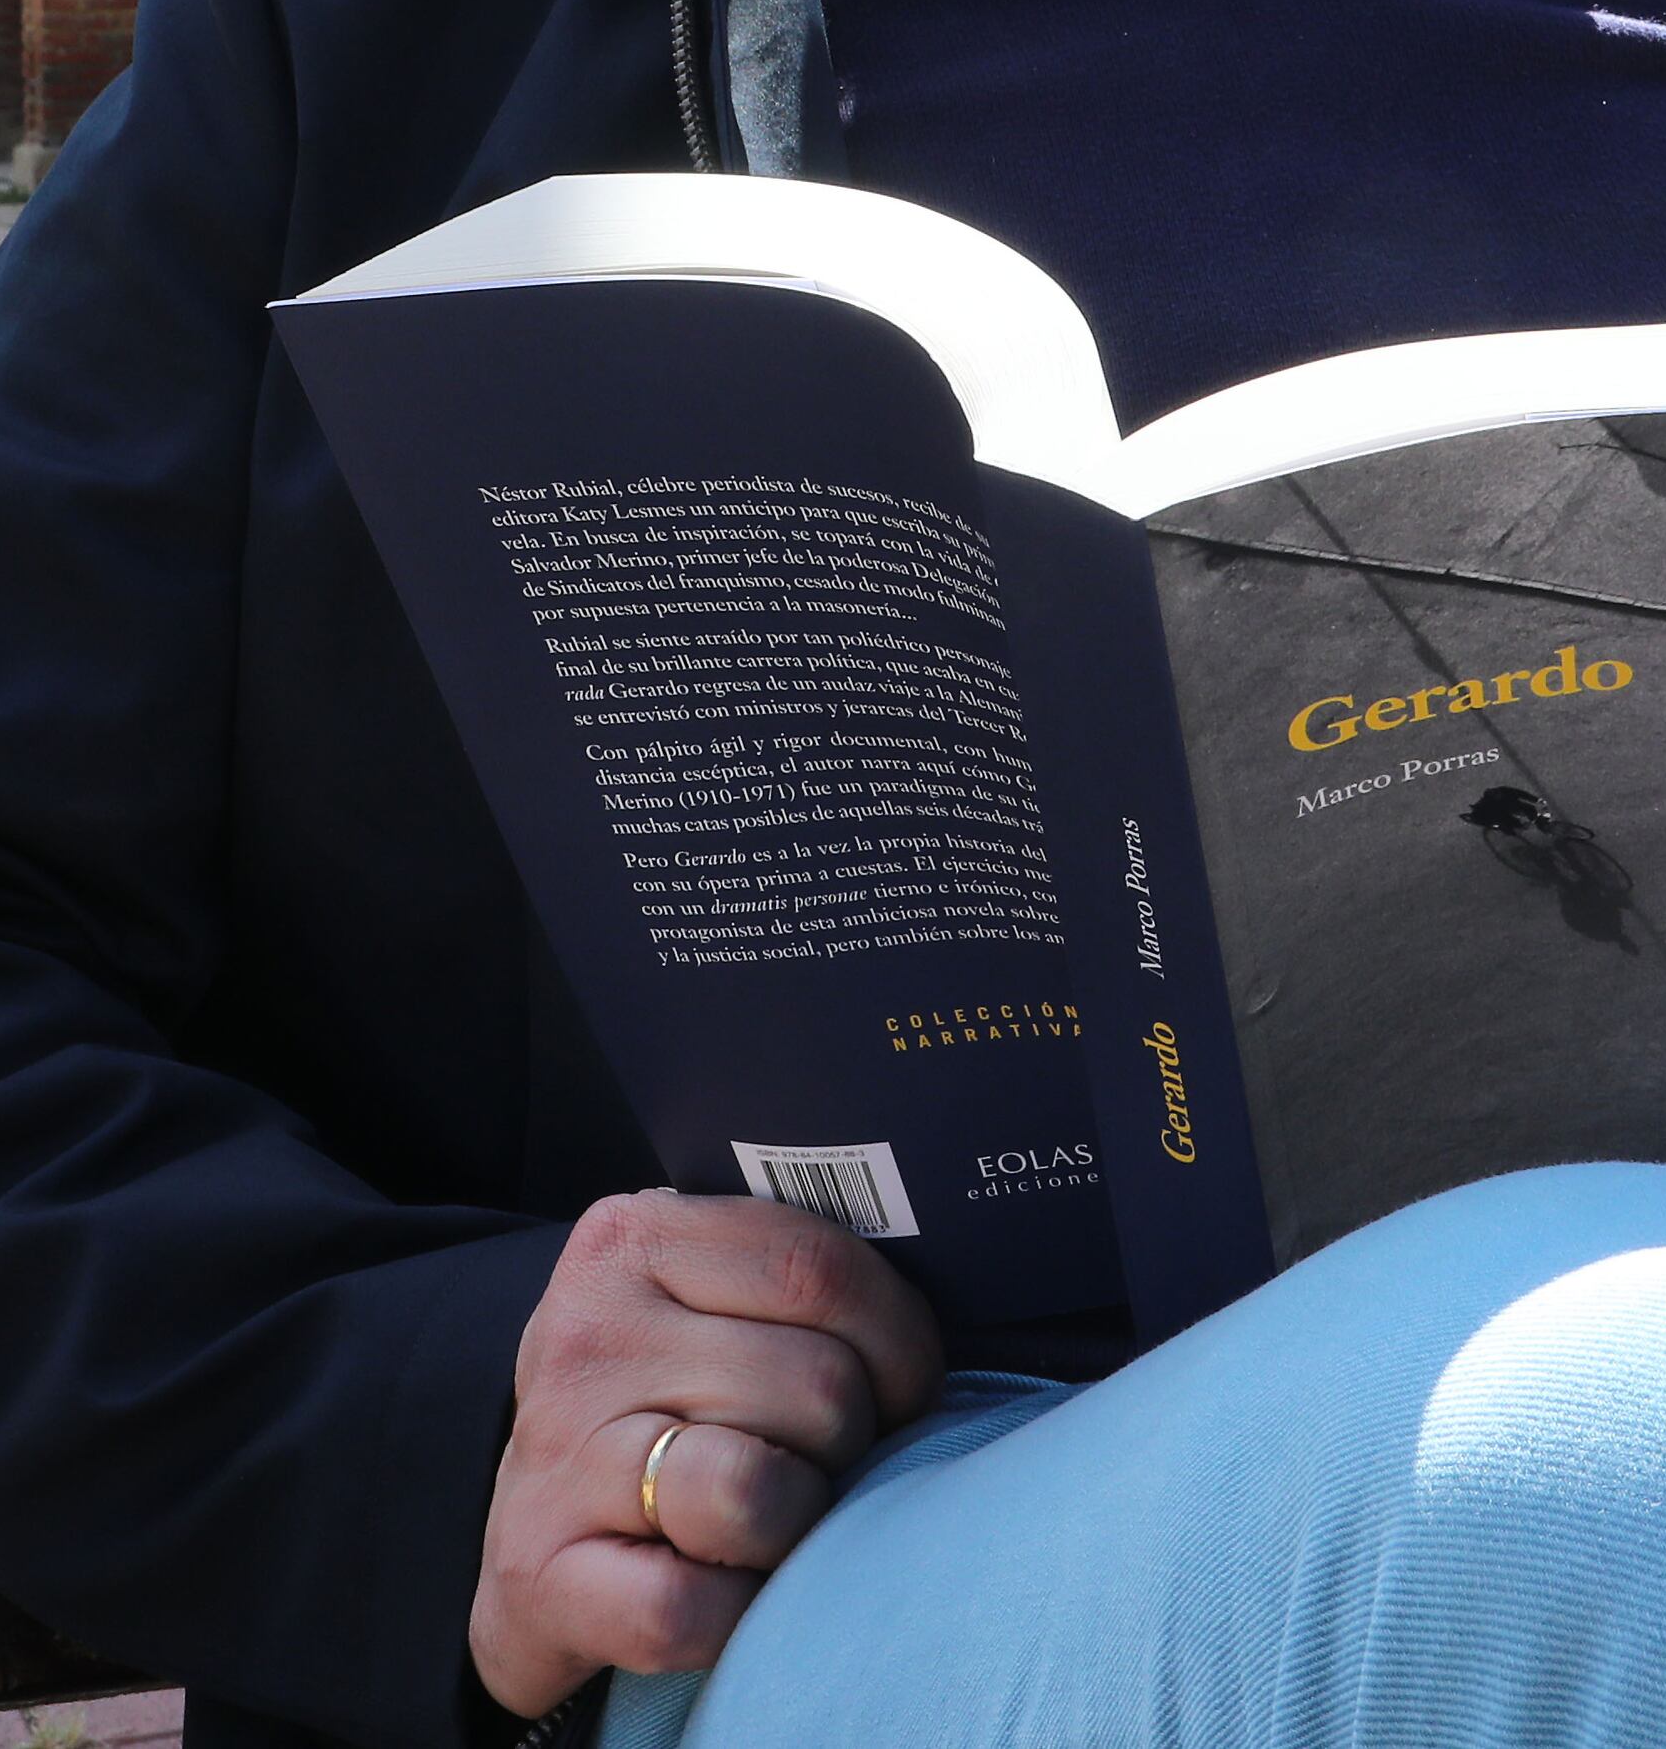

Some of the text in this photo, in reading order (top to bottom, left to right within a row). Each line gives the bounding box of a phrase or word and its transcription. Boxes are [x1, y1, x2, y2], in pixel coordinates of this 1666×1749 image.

[477, 474, 952, 525] Néstor Rubial, célebre periodista de sucesos, recibe
[491, 499, 941, 541] editora Katy Lesmes un anticipo para que escriba
[500, 523, 972, 575] vela. En busca de inspiración, se topará con la vida
[510, 547, 1001, 610] Salvador Merino, primer jefe de la poderosa Delegación
[522, 581, 546, 598] de
[546, 577, 644, 596] Sindicatos
[646, 573, 676, 591] del
[678, 572, 792, 593] franquismo,
[793, 573, 856, 591] cesado
[858, 575, 881, 594] de
[882, 583, 936, 603] modo
[532, 595, 918, 626] por supuesta pertenencia la masonería...
[544, 628, 1012, 679] Rubial se siente atraído por tan poliédrico personaje
[555, 652, 972, 685] final de su brillante carrera política, que acaba
[564, 674, 955, 702] rada Gerardo regresa de un audaz viaje la
[1288, 646, 1634, 752] Gerardo
[573, 698, 1006, 735] se entrevistó con ministros jerarcas del Tercer
[585, 730, 988, 764] Con pálpito ágil rigor documental, con
[595, 756, 1012, 786] distancia escéptica, el autor narra aquí cómo
[1296, 747, 1501, 818] Marco Porras
[601, 777, 994, 811] Merino (1910-1971) fue un paradigma de
[611, 799, 1020, 835] muchas catas posibles de aquellas seis décadas
[622, 832, 1048, 869] Pero Gerardo es la vez la propia historia del
[632, 855, 1020, 895] con su ópera prima cuestas. El ejercicio
[641, 878, 1028, 916] con un dramatis personae tierno irónico,
[1122, 817, 1165, 980] Marco Porras
[649, 901, 1061, 944] protagonista de esta ambiciosa novela sobre
[671, 923, 1041, 967] la justicia social, pero también sobre los
[885, 1001, 1079, 1032] COLECCIÓN
[1142, 1020, 1197, 1164] Gerardo
[976, 1143, 1094, 1179] EOLAS
[966, 1171, 1100, 1200] edicione
